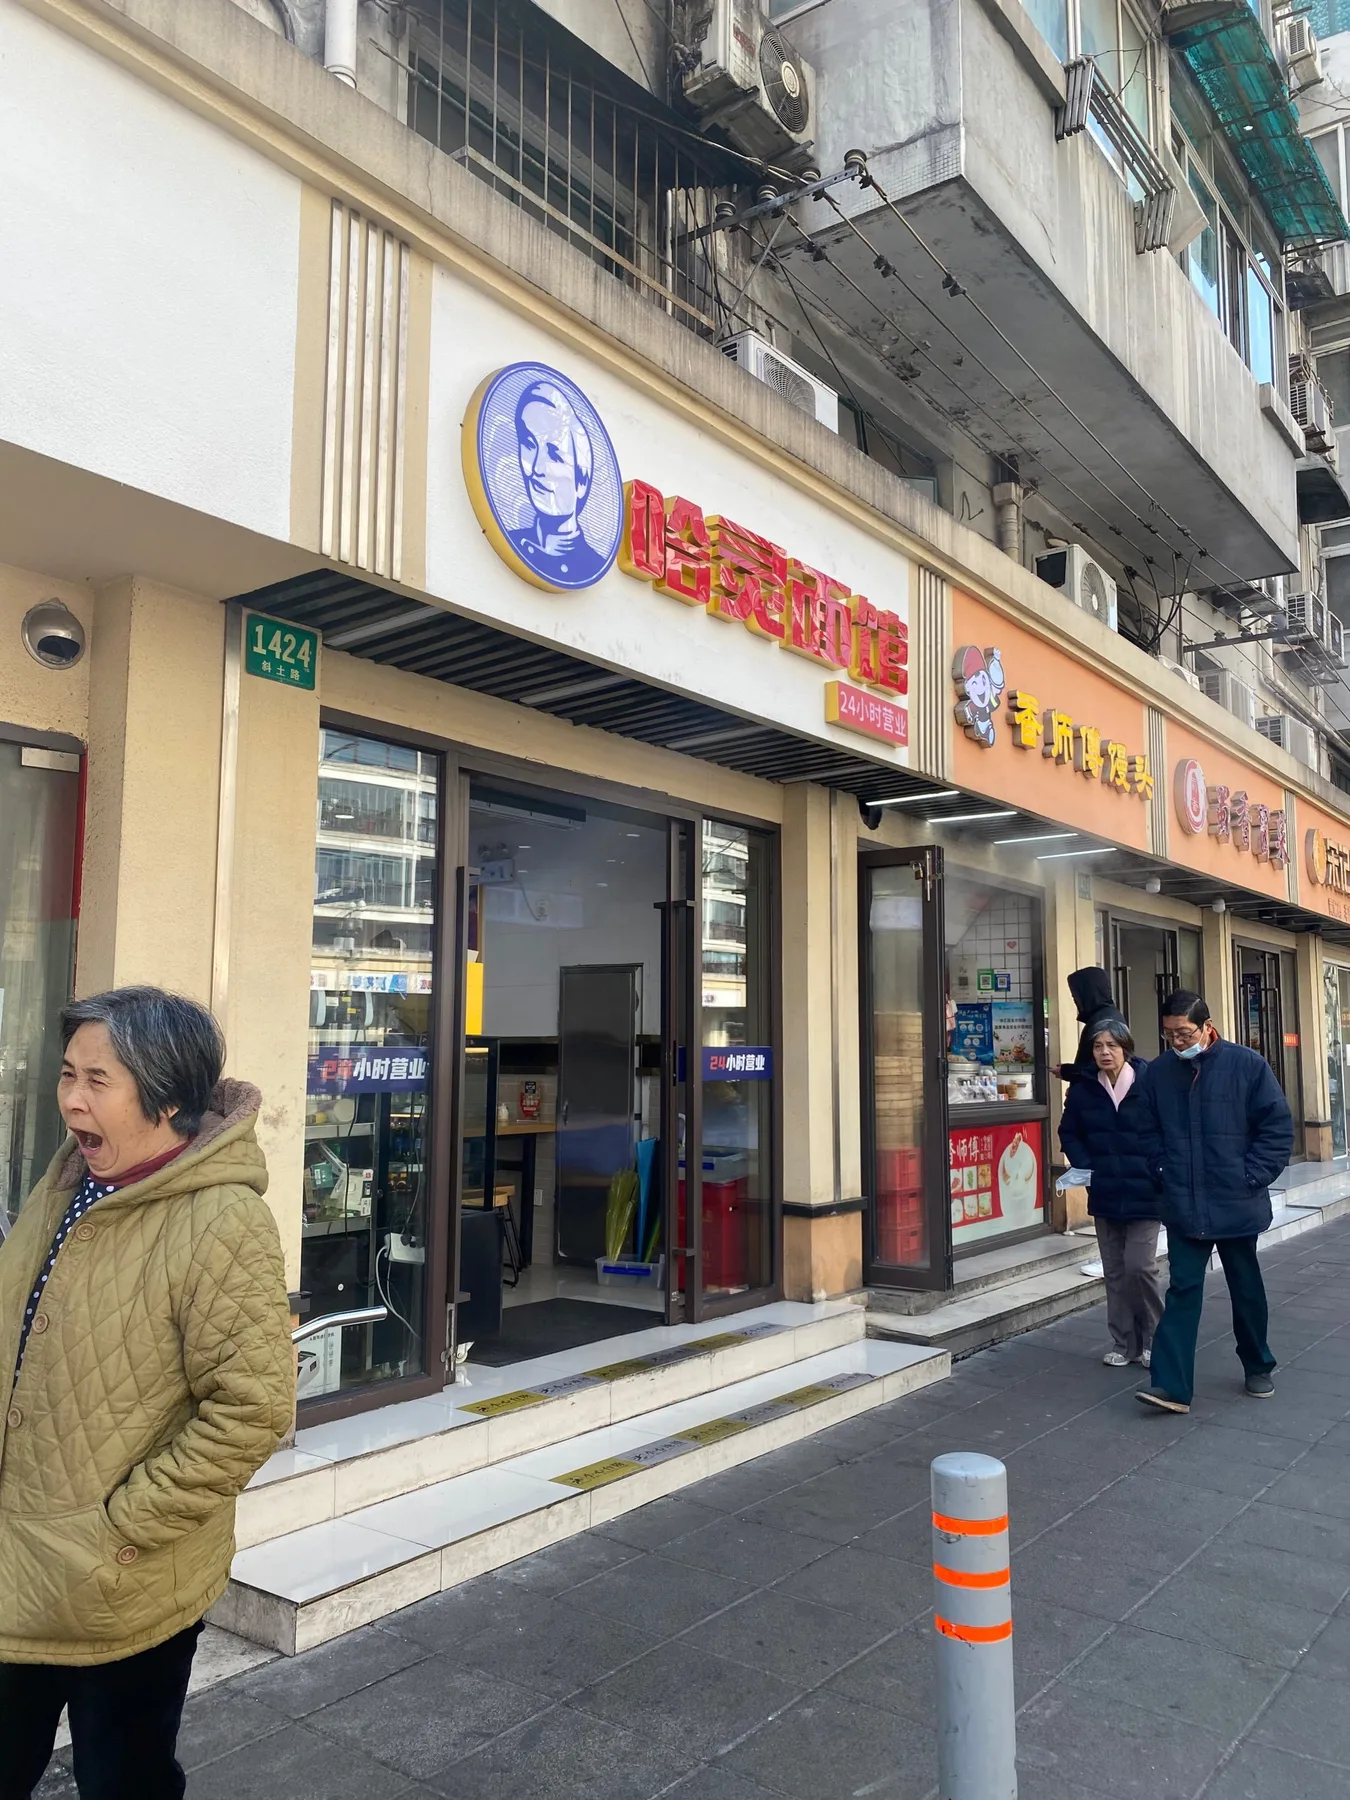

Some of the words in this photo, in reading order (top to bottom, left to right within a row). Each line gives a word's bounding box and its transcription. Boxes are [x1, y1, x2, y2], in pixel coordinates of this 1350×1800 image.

[620, 479, 908, 696] 哈灵面馆
[253, 625, 310, 668] 1424
[261, 660, 300, 681] 斜土路
[840, 690, 906, 738] 24小时营业
[1010, 690, 1154, 800] 香师傅馒头
[710, 1053, 765, 1071] 24小时营业
